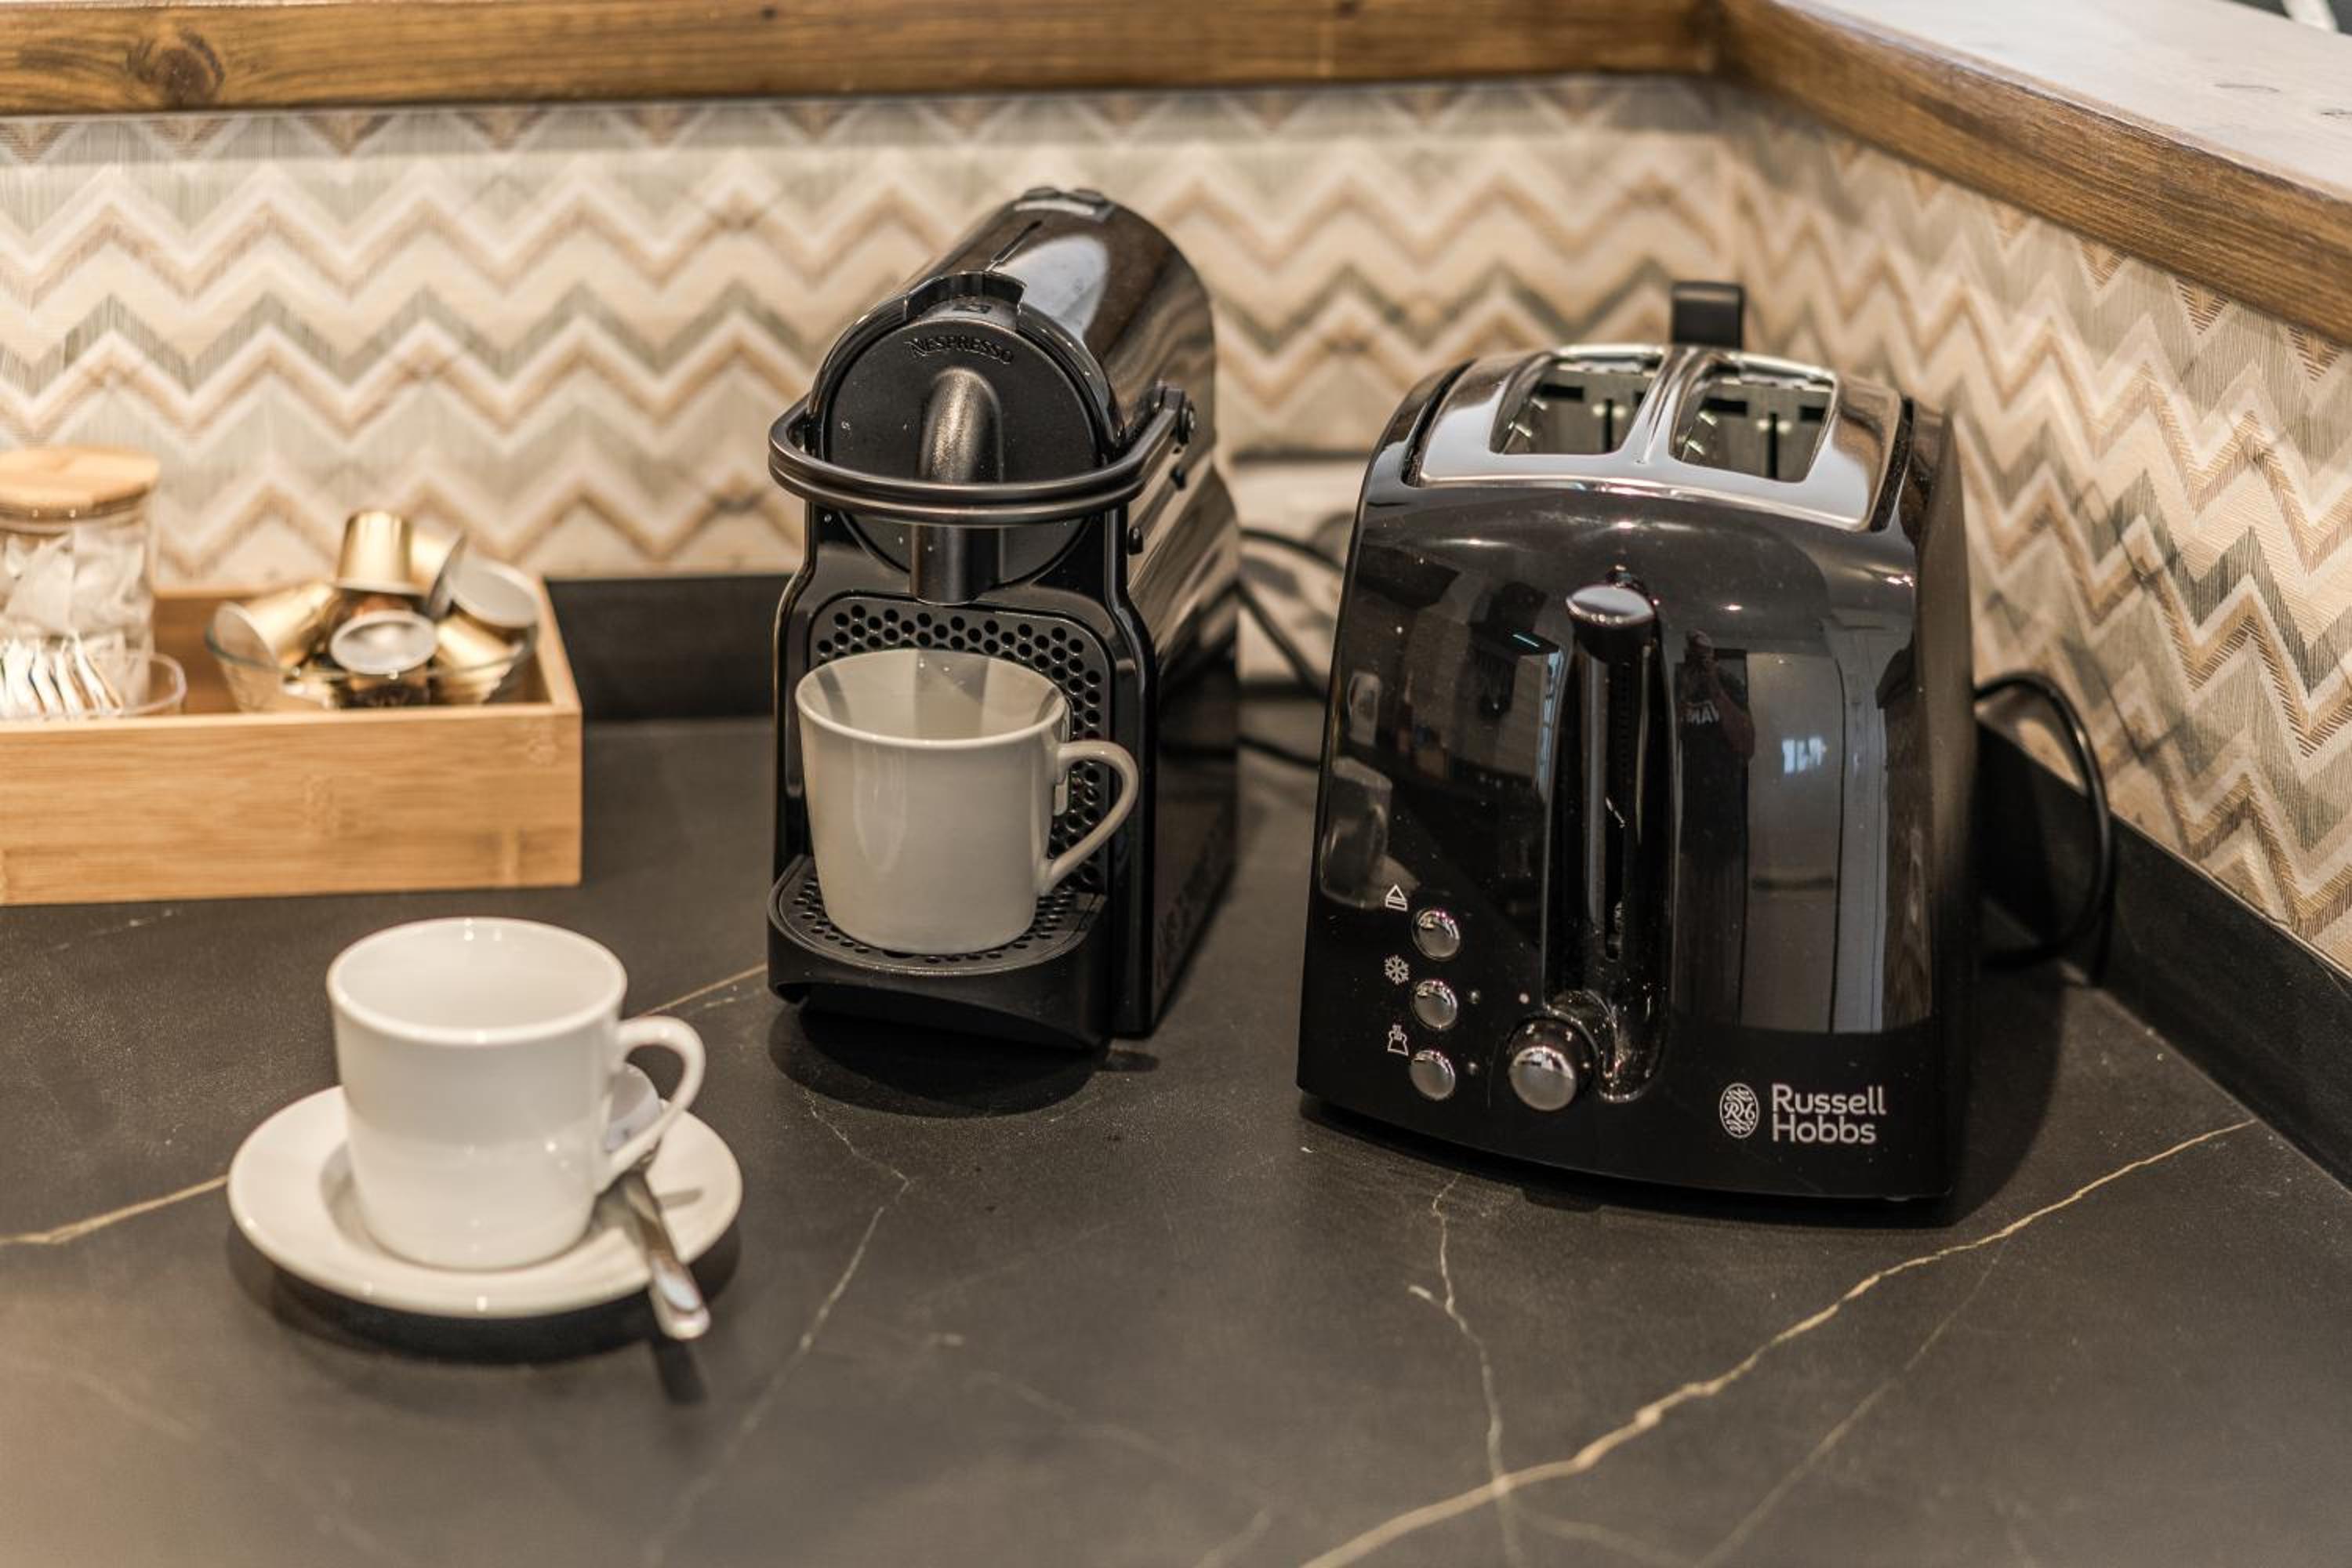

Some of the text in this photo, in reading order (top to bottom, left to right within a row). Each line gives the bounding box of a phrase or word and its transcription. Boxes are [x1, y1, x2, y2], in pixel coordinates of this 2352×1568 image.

[903, 335, 1014, 365] NESPRESSO
[1771, 1083, 1887, 1115] Russell
[1772, 1112, 1876, 1144] Hobbs
